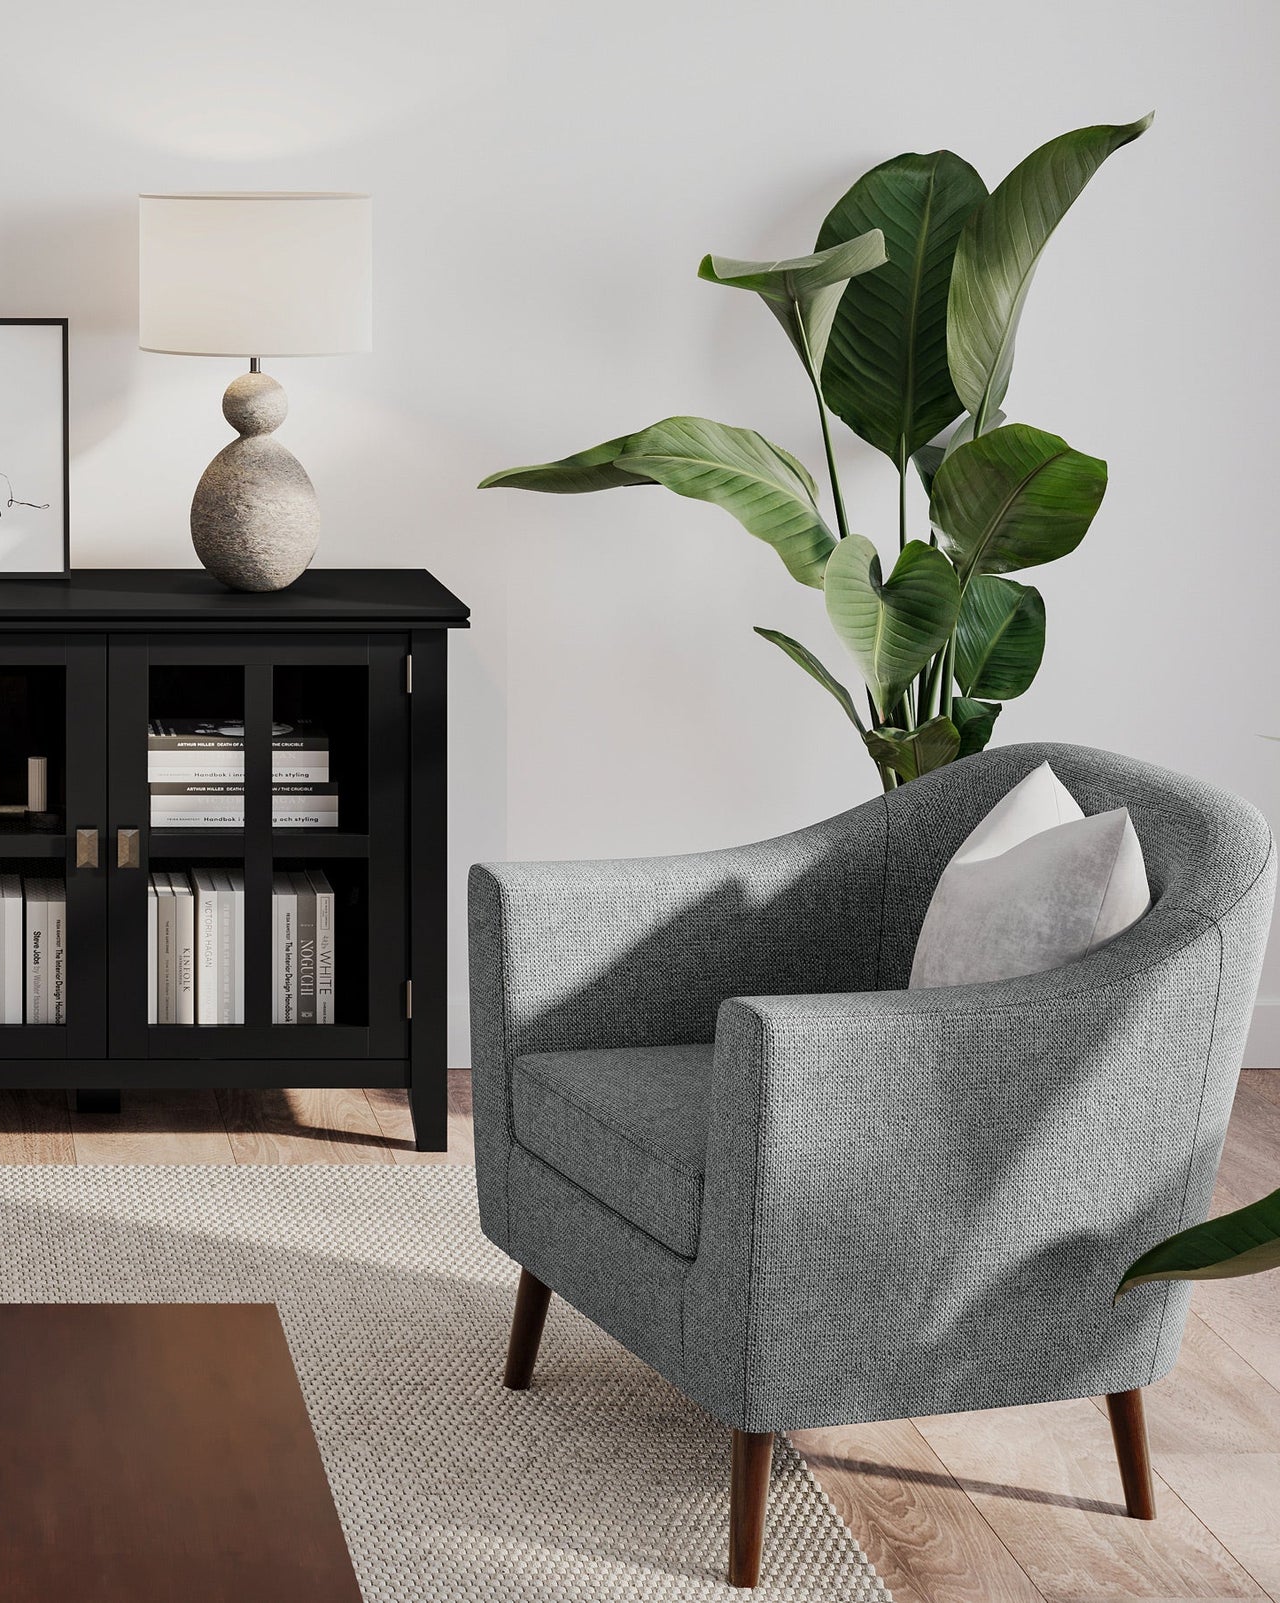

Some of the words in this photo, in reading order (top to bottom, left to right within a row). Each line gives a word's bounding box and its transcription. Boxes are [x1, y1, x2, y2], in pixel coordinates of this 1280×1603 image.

[204, 900, 213, 938] VICTORIA
[32, 931, 41, 949] Steve
[284, 942, 293, 952] The
[32, 949, 41, 965] Jobs
[55, 949, 63, 959] The
[204, 940, 213, 968] HAGAN
[284, 953, 293, 973] Interior
[32, 966, 41, 974] by
[55, 960, 63, 980] Interior
[183, 948, 191, 993] KINFOLK
[300, 940, 314, 996] NOGUCHI
[319, 950, 332, 995] WHITE
[32, 974, 41, 995] Walter
[55, 980, 63, 1000] Design
[284, 973, 293, 992] Design
[284, 994, 293, 1023] Handbook
